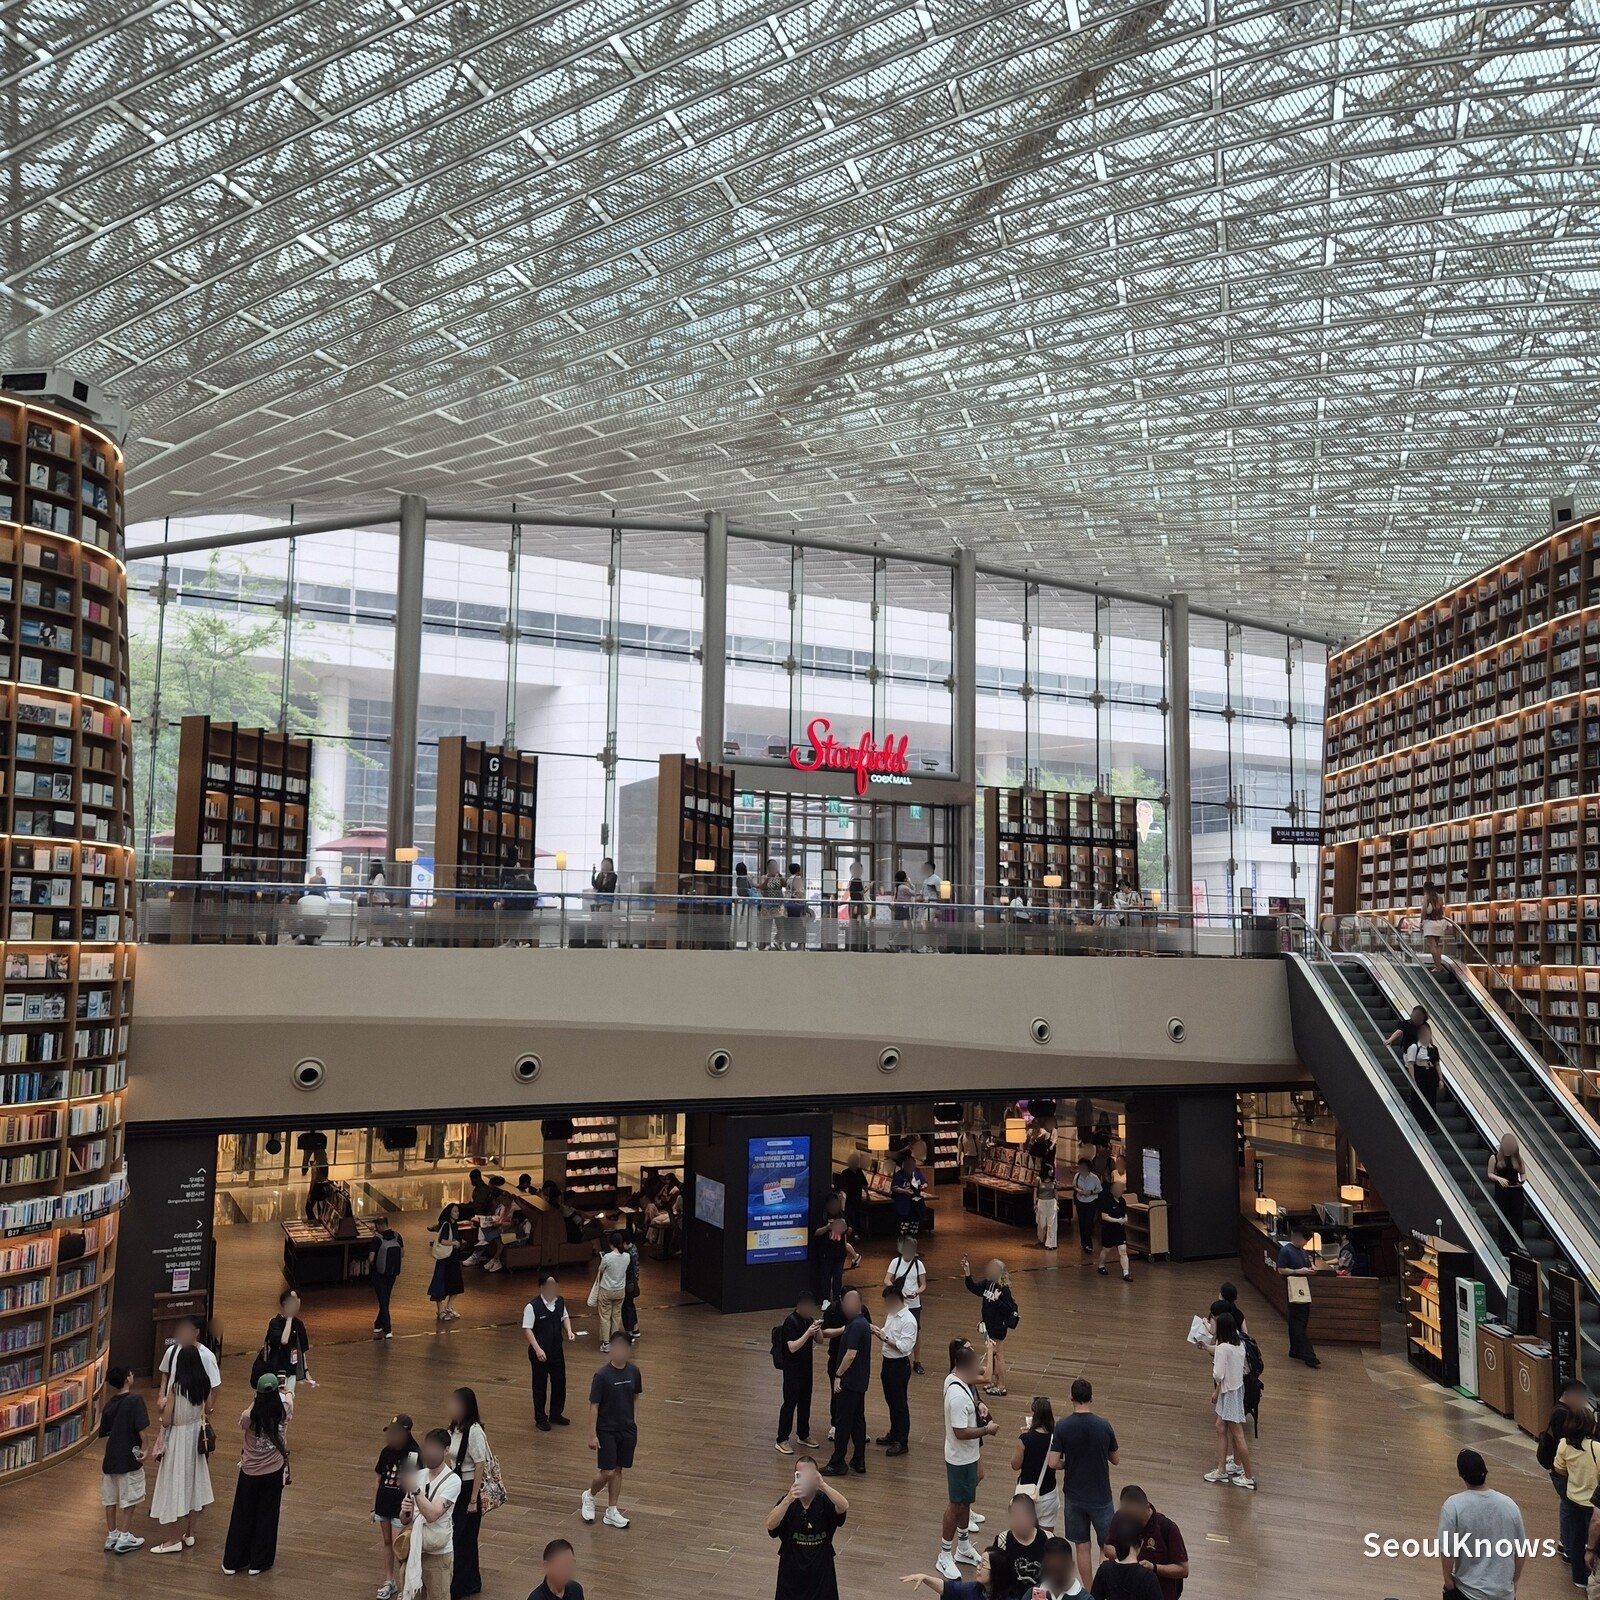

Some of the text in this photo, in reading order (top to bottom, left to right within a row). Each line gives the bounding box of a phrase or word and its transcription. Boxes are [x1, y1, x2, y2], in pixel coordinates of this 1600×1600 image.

[790, 718, 909, 796] Starfield
[489, 757, 500, 772] G
[893, 776, 912, 785] MALL
[7, 1229, 20, 1237] B27
